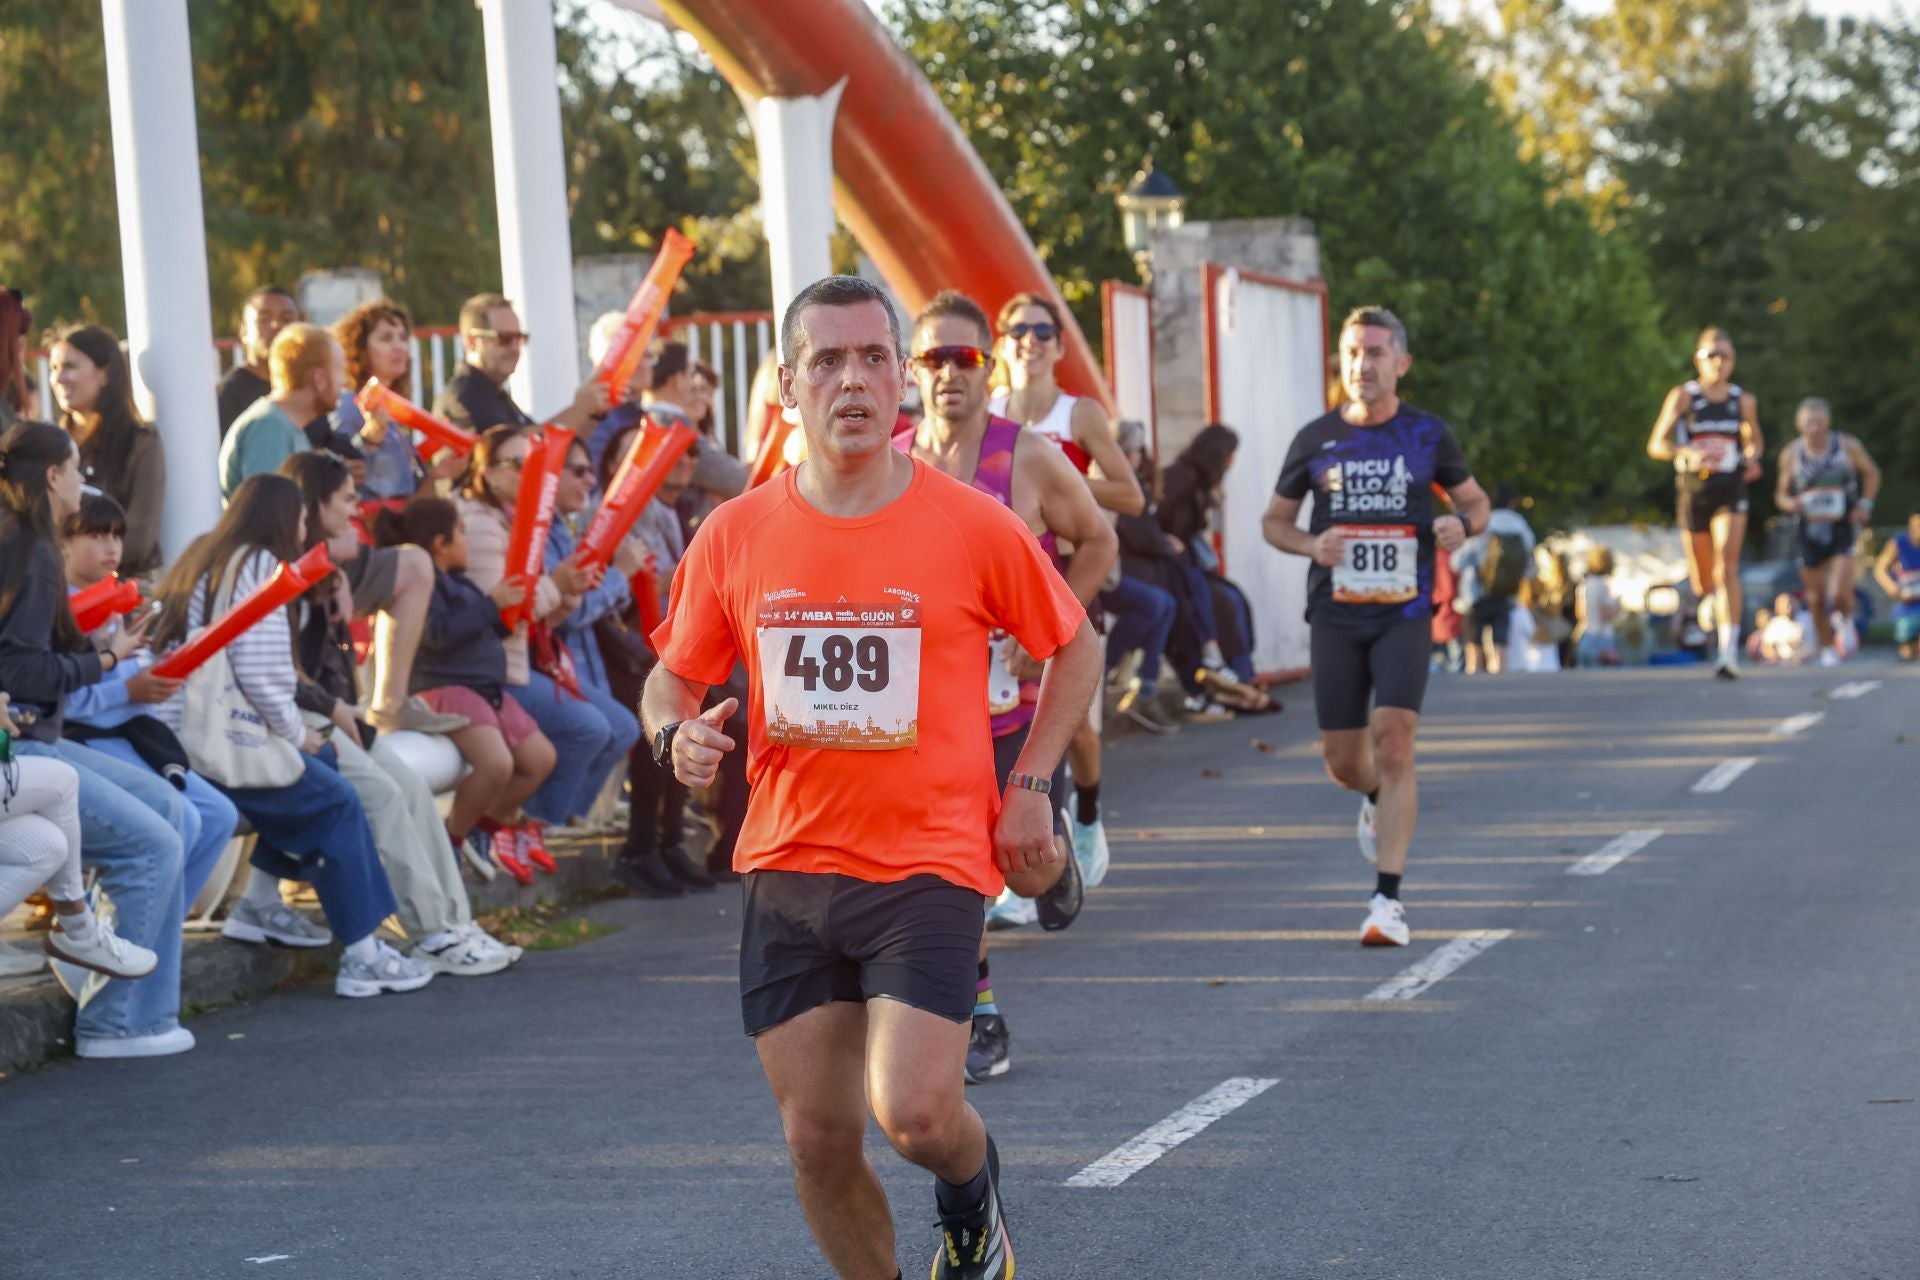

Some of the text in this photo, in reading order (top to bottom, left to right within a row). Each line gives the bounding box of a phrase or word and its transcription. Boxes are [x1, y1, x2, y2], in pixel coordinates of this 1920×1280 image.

[1346, 460, 1390, 476] PICU
[1346, 477, 1383, 494] LLO
[1347, 494, 1407, 511] SORIO
[1353, 543, 1398, 571] 818
[883, 587, 913, 599] LABORAL
[802, 611, 834, 621] MBA
[861, 609, 895, 622] GIJÓN
[784, 634, 889, 692] 489
[840, 702, 859, 711] DÍEZ
